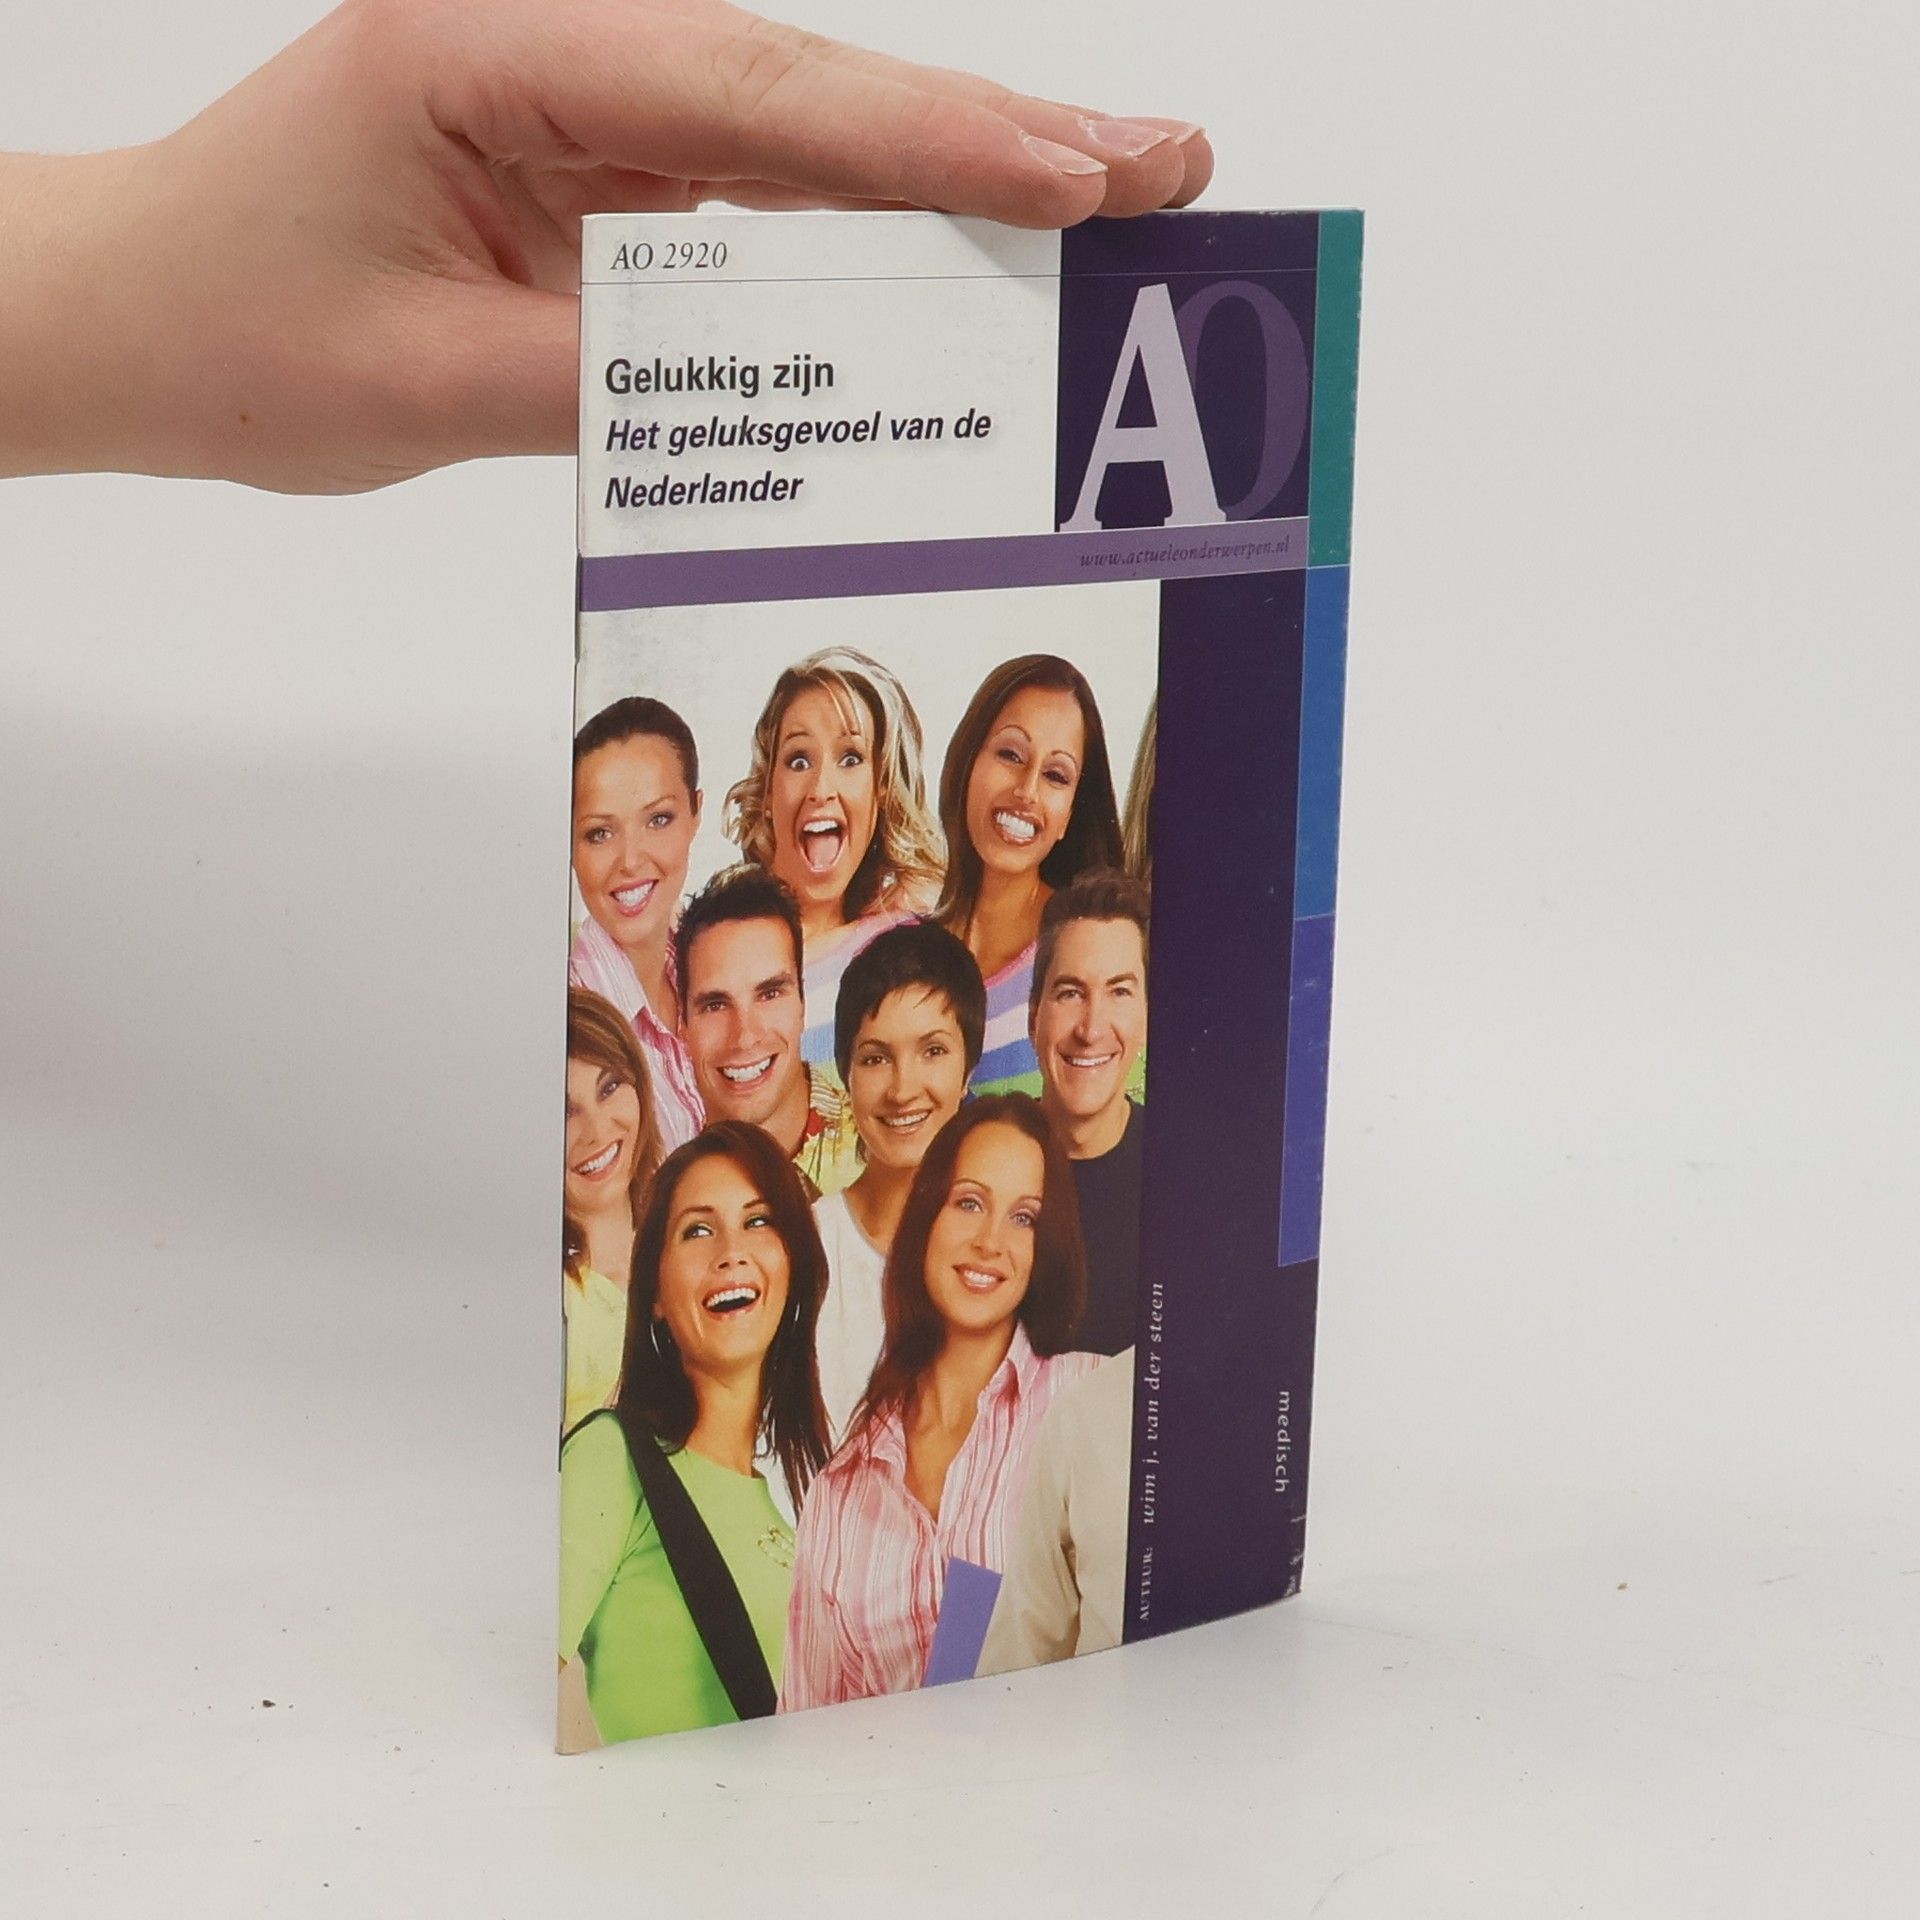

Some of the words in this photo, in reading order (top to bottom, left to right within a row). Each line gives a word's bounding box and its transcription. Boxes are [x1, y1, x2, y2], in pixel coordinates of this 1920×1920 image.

[610, 242, 654, 270] AO
[662, 242, 728, 269] 2920
[605, 356, 760, 398] Gelukkig
[773, 354, 835, 396] zijn
[1059, 280, 1310, 533] AO
[605, 419, 661, 452] Het
[668, 411, 881, 456] geluksgevoel
[890, 415, 944, 441] van
[953, 408, 992, 439] de
[604, 471, 804, 509] Nederlander
[1079, 535, 1291, 568] www.actueleonderwerpen.nl
[1149, 1282, 1164, 1343] steen
[1144, 1351, 1162, 1391] der
[1147, 1400, 1160, 1441] van
[1274, 1390, 1292, 1493] medisch
[1142, 1450, 1160, 1465] j.
[1140, 1473, 1156, 1524] wim
